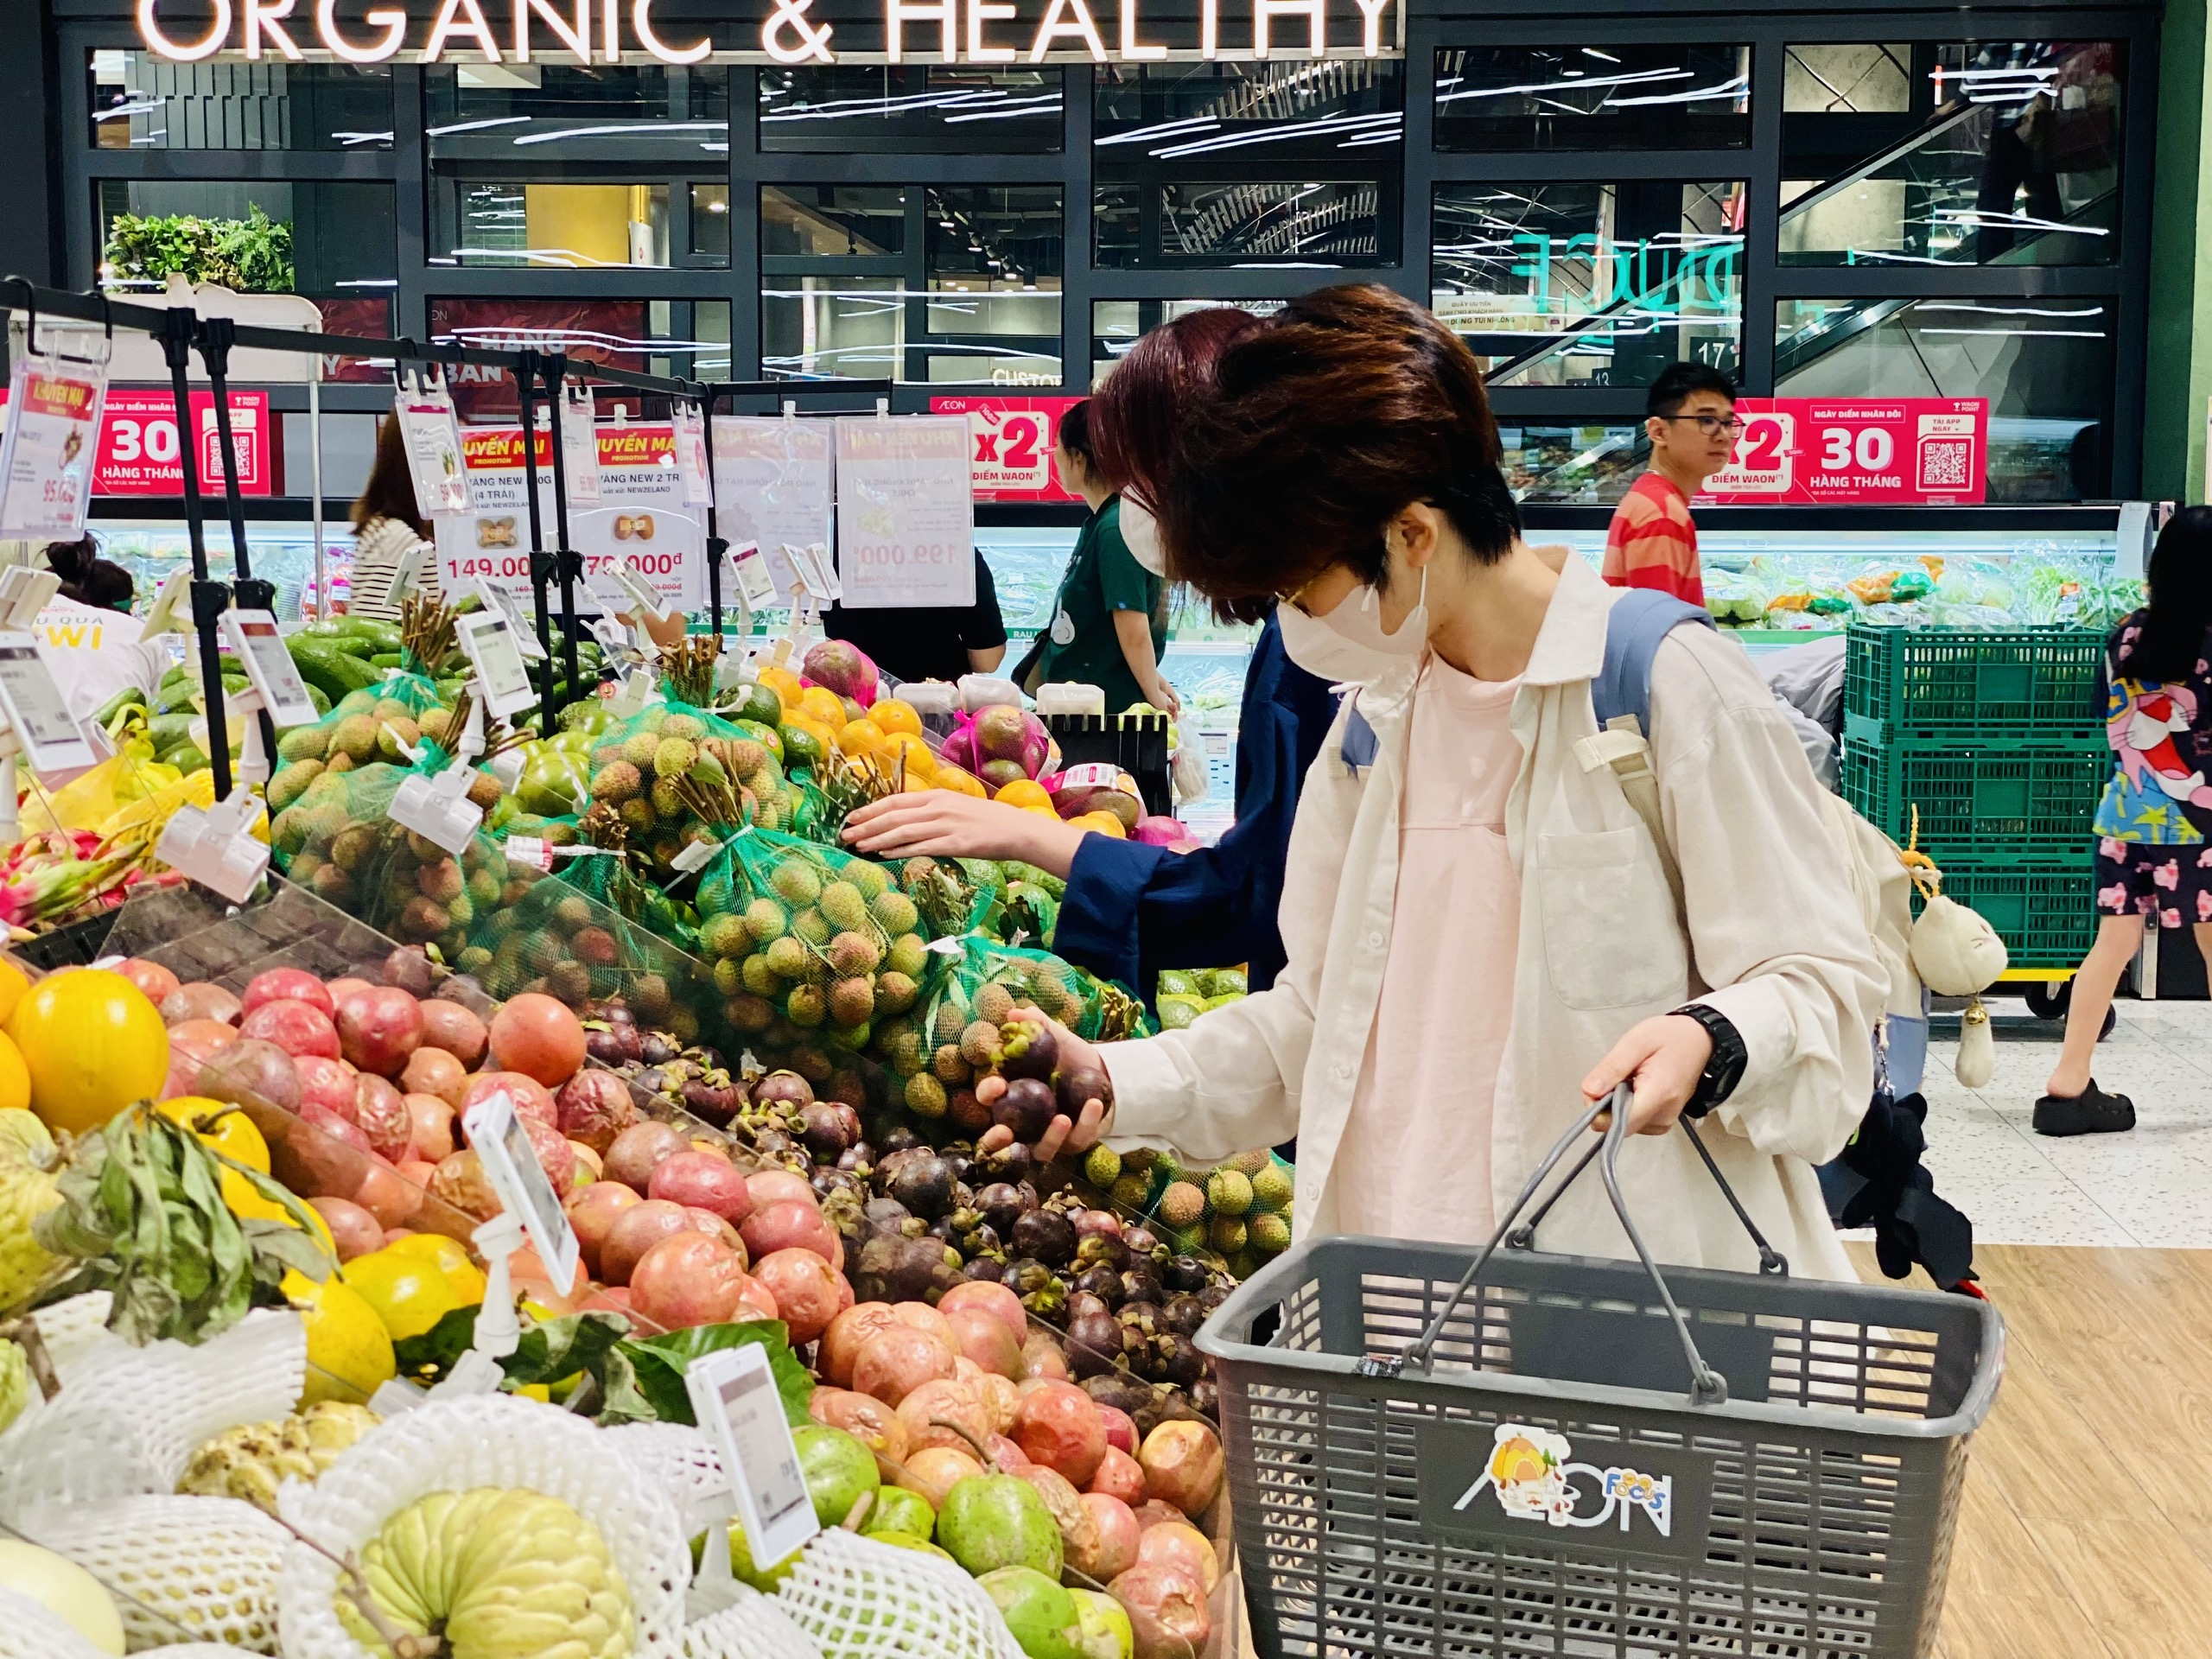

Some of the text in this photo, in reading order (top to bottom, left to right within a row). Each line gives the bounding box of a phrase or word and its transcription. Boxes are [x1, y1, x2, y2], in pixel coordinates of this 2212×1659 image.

[138, 0, 714, 65] ORGANIC
[762, 0, 835, 61] &
[1698, 341, 1726, 369] 17
[111, 419, 181, 461] 30
[463, 435, 509, 456] UYẾN
[597, 432, 647, 453] UYẾN
[1821, 427, 1894, 471] 30
[102, 464, 140, 479] HÀNG
[469, 475, 495, 486] ÀNG
[499, 476, 523, 486] NEW
[601, 473, 680, 483] ÀNG NEW 2 TR
[1809, 473, 1902, 488] HÀNG THÁNG
[47, 625, 103, 651] WI
[1606, 1472, 1667, 1510] FOCUS
